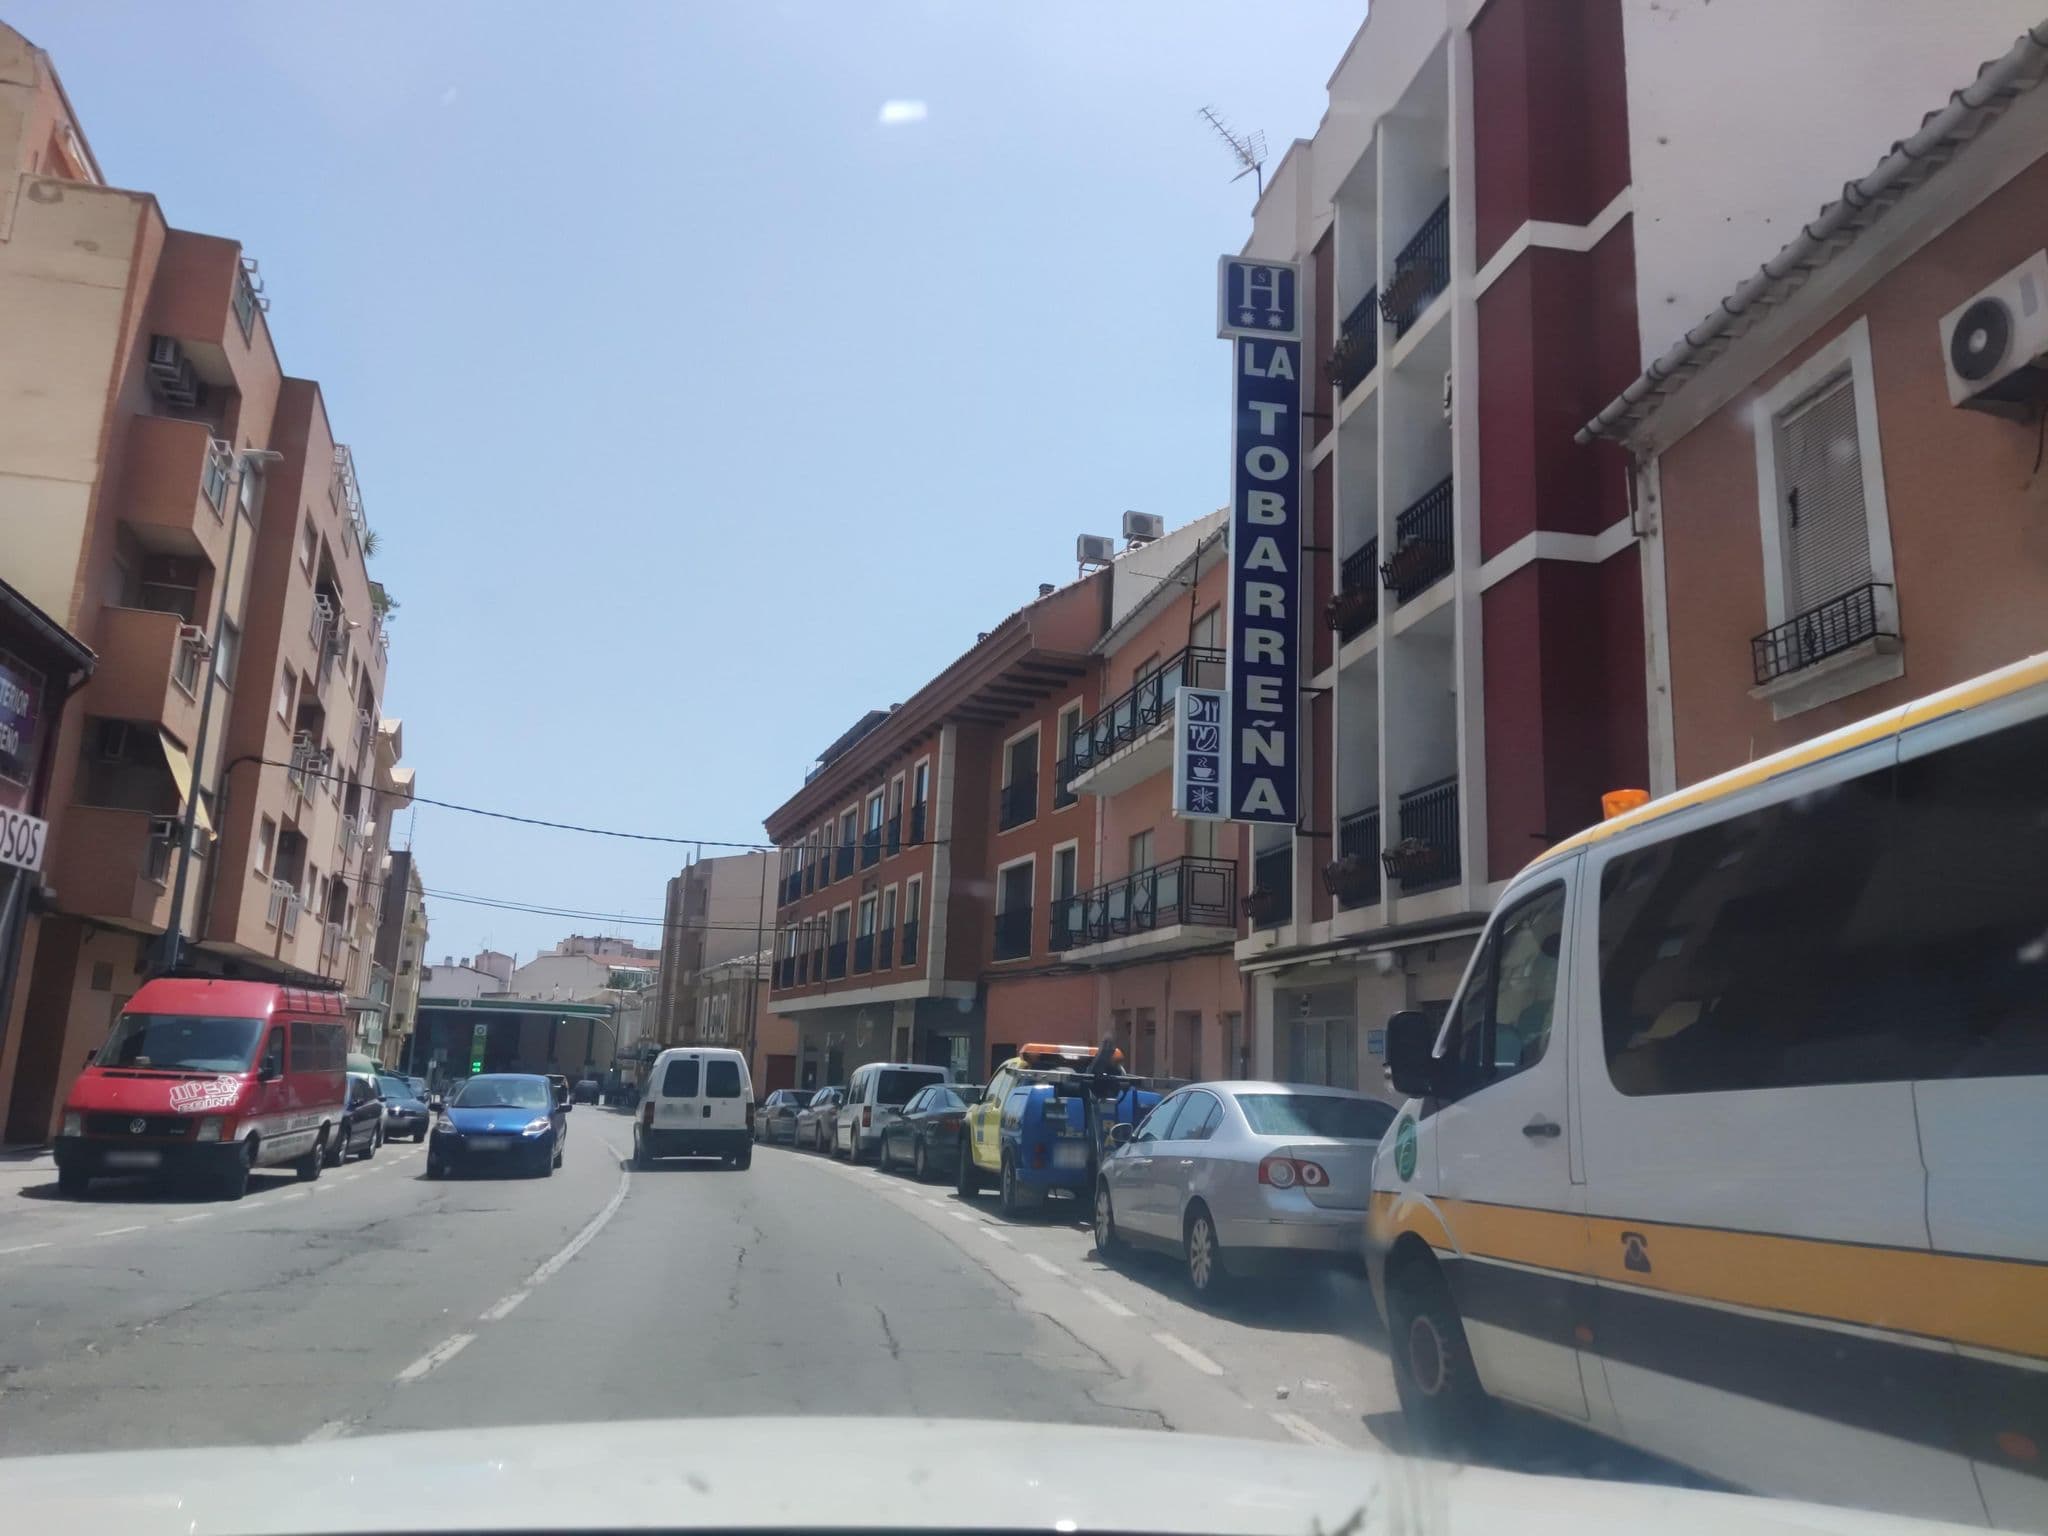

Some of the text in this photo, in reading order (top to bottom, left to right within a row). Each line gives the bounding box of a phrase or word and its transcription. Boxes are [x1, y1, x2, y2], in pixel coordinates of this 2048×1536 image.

[1238, 264, 1285, 313] H
[1244, 342, 1295, 380] LA
[1240, 400, 1290, 816] TOBARREÑA
[1189, 725, 1208, 741] TV
